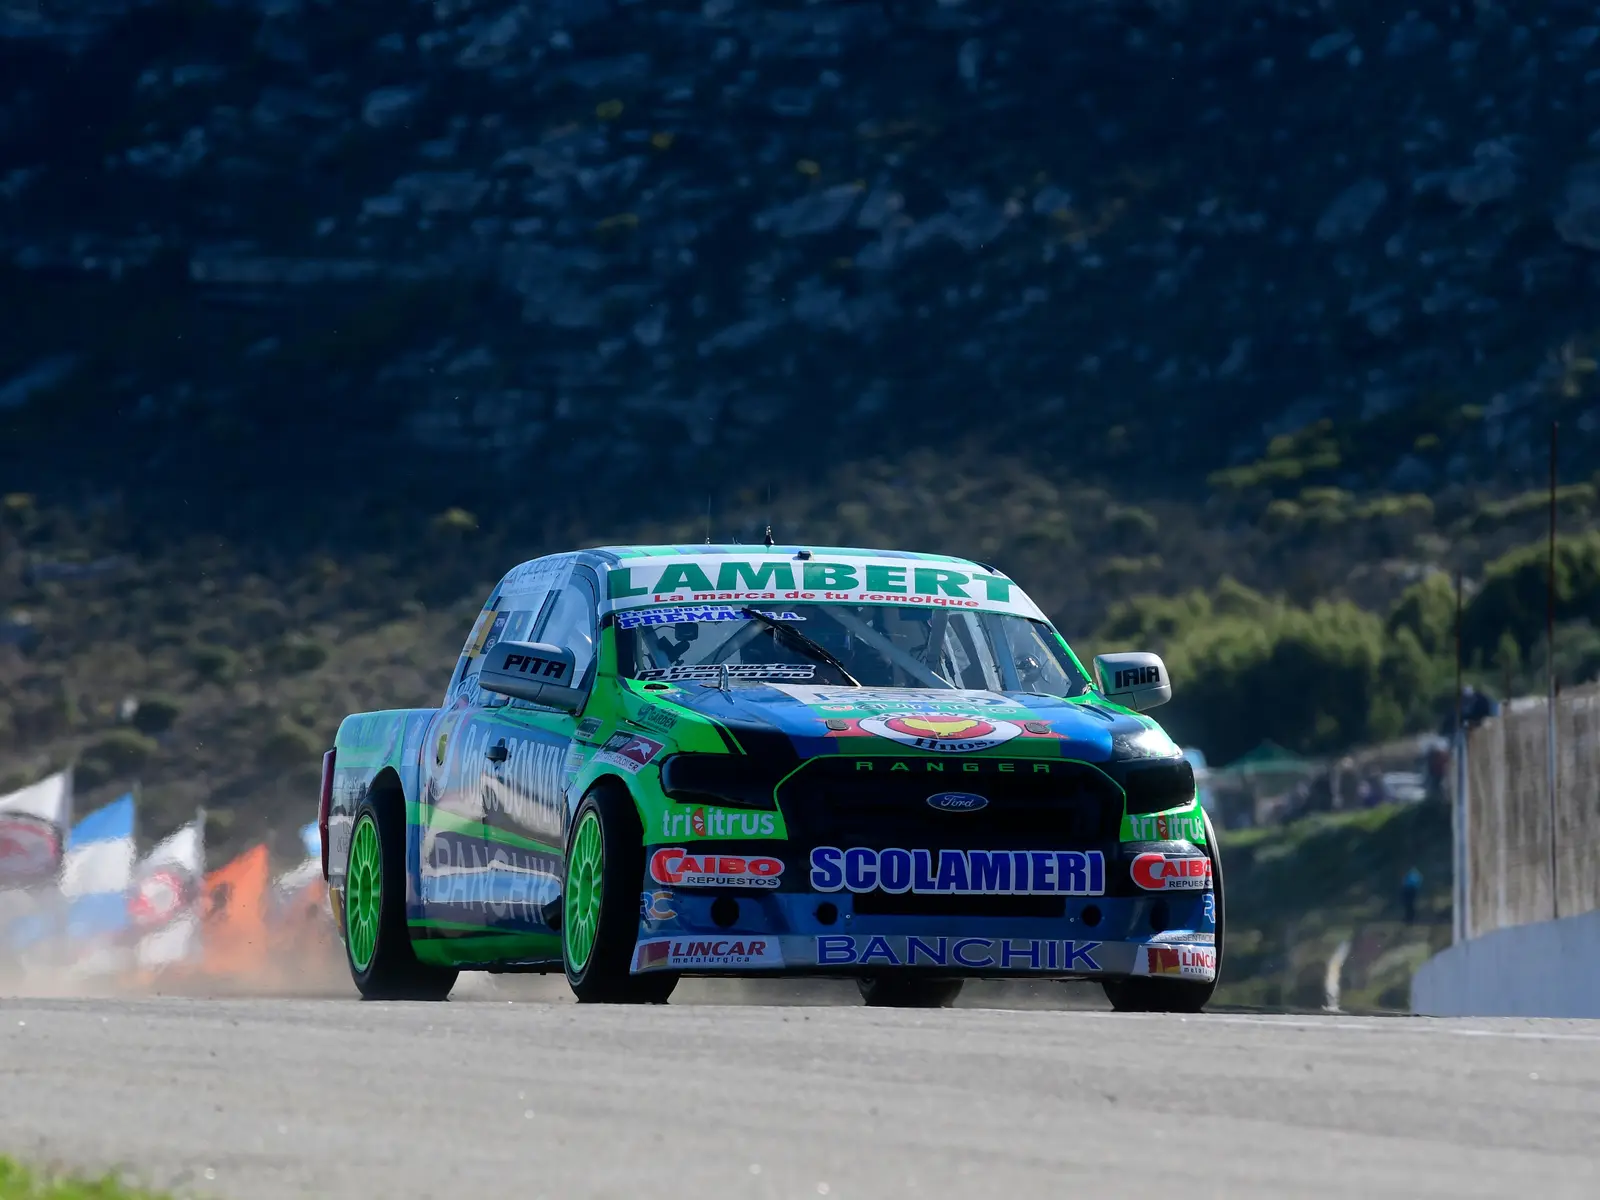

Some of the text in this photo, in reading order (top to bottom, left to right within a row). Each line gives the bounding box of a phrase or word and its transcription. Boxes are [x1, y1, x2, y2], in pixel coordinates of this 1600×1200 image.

[608, 561, 1014, 603] LAMBERT
[654, 590, 980, 609] La marca de tu remolque
[619, 605, 730, 618] Transportes
[502, 654, 567, 679] PITA
[912, 736, 996, 751] Hnos.
[856, 761, 1050, 773] RANGER
[940, 794, 976, 808] Ford
[651, 849, 782, 883] CAIBO
[811, 848, 1104, 896] SCOLAMIERI
[687, 876, 778, 886] REPUESTOS
[672, 940, 767, 957] LINCAR
[816, 935, 1104, 971] BANCHIK
[1182, 951, 1215, 969] LINCA
